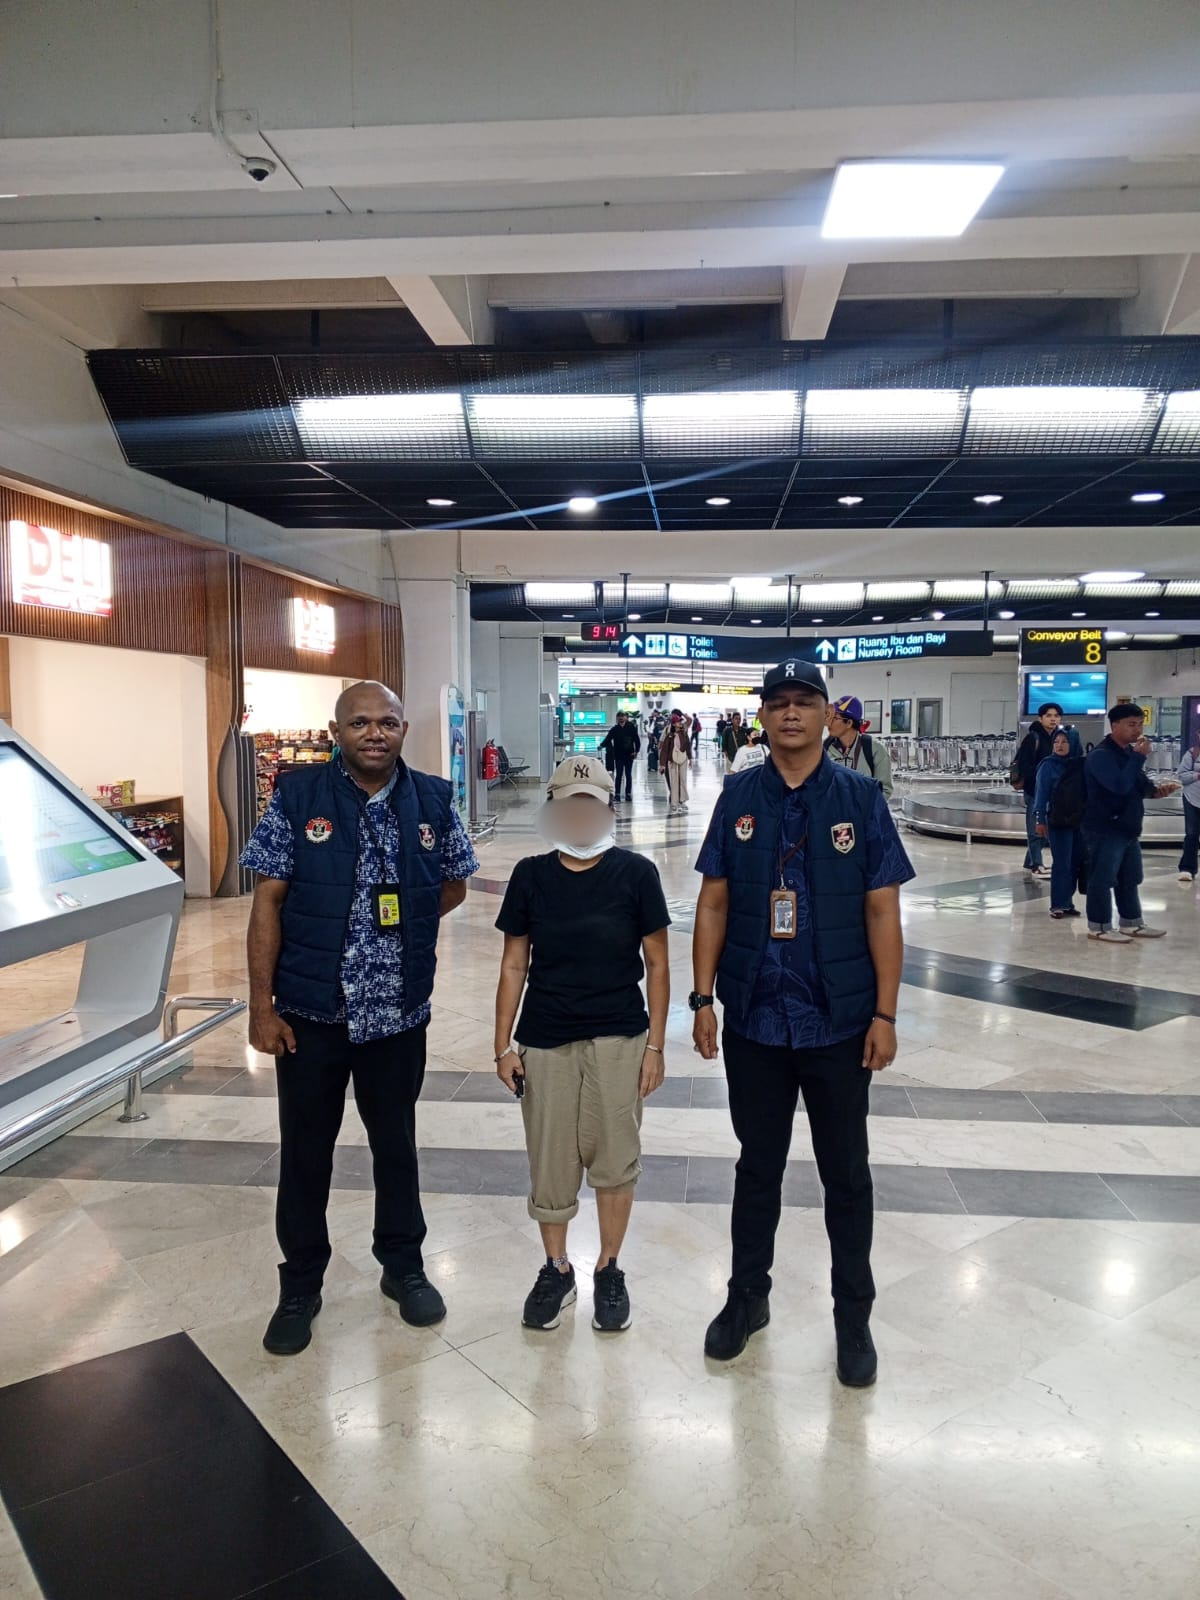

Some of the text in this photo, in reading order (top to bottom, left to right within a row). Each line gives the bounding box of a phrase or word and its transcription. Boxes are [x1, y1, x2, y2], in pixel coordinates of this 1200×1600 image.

[592, 626, 617, 638] 9 14
[1027, 629, 1102, 643] Conveyor Belt
[690, 635, 714, 647] Toilet
[858, 632, 946, 648] Ruang Ibu dan Bayi
[690, 647, 718, 659] Toilets
[858, 645, 922, 659] Nursery Room
[1085, 642, 1101, 663] 8
[573, 764, 590, 778] NY
